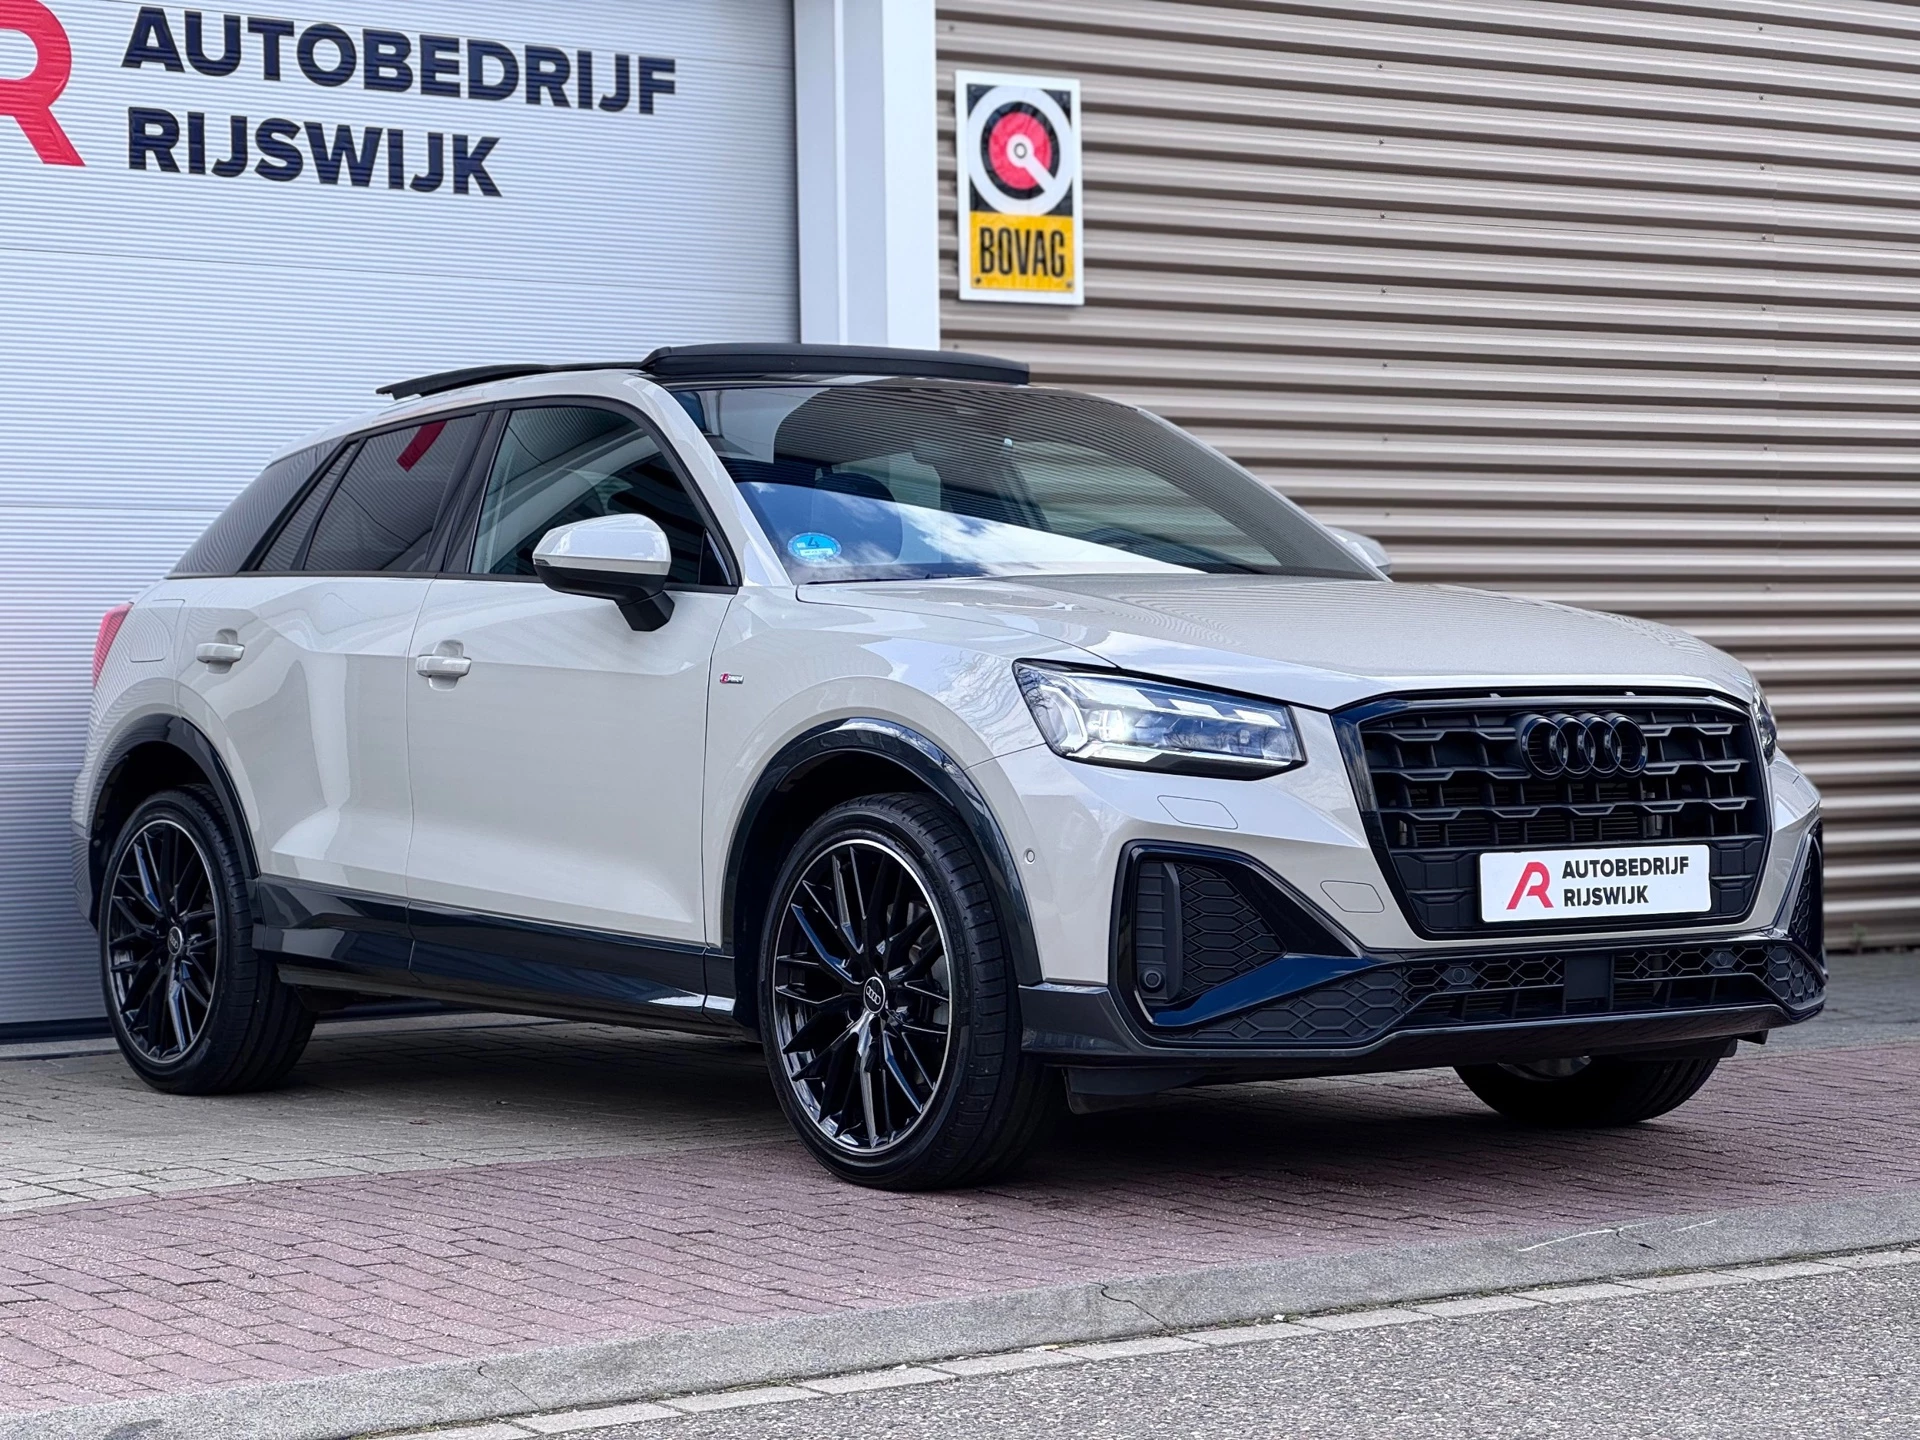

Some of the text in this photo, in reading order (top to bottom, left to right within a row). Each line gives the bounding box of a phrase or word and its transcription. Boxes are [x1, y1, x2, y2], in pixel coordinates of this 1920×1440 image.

[121, 7, 676, 115] AUTOBEDRIJF
[128, 106, 502, 198] RIJSWIJK
[979, 226, 1065, 278] BOVAG
[1561, 856, 1689, 879] AUTOBEDRIJF
[1563, 885, 1649, 907] RIJSWIJK
